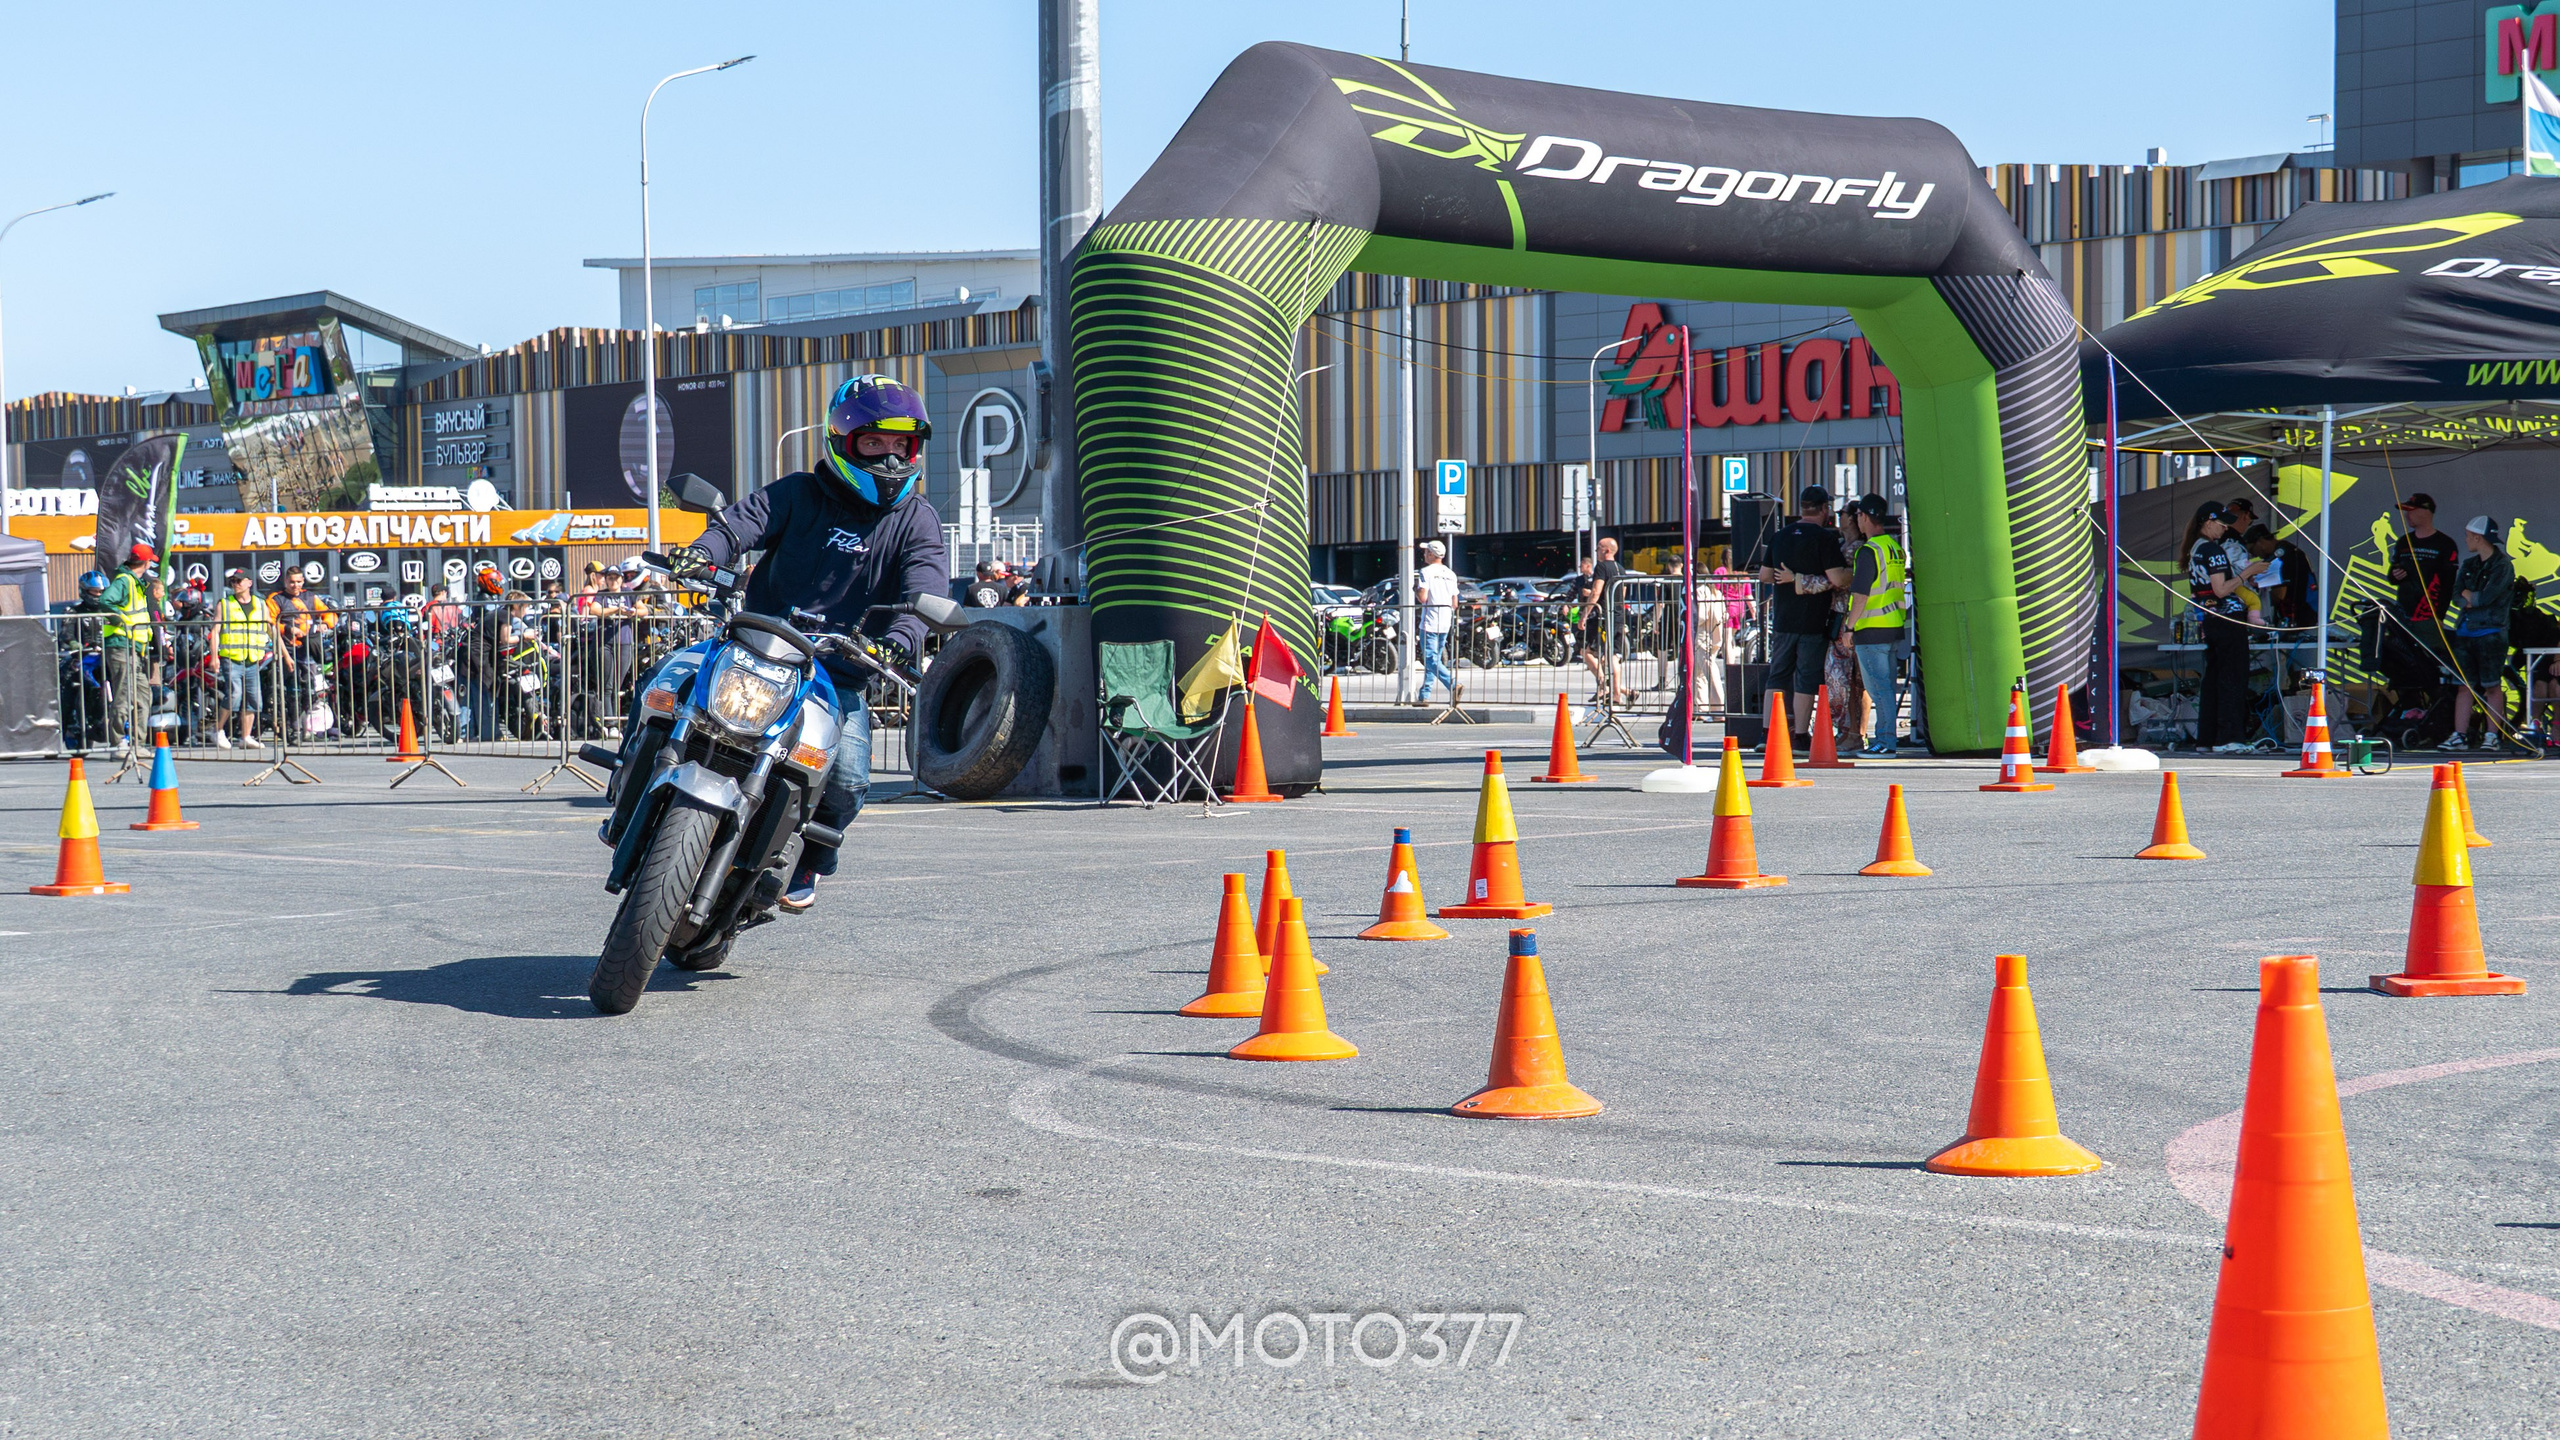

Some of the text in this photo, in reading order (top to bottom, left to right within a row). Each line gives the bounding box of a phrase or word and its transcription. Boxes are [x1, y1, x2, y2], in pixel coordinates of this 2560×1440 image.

[1516, 135, 1935, 220] Dragonfly
[435, 403, 485, 434] ВКУСНЫЙ
[178, 469, 204, 489] LIME
[1444, 464, 1462, 493] P
[1729, 461, 1744, 489] P
[241, 514, 491, 547] АВТОЗАПЧАСТИ
